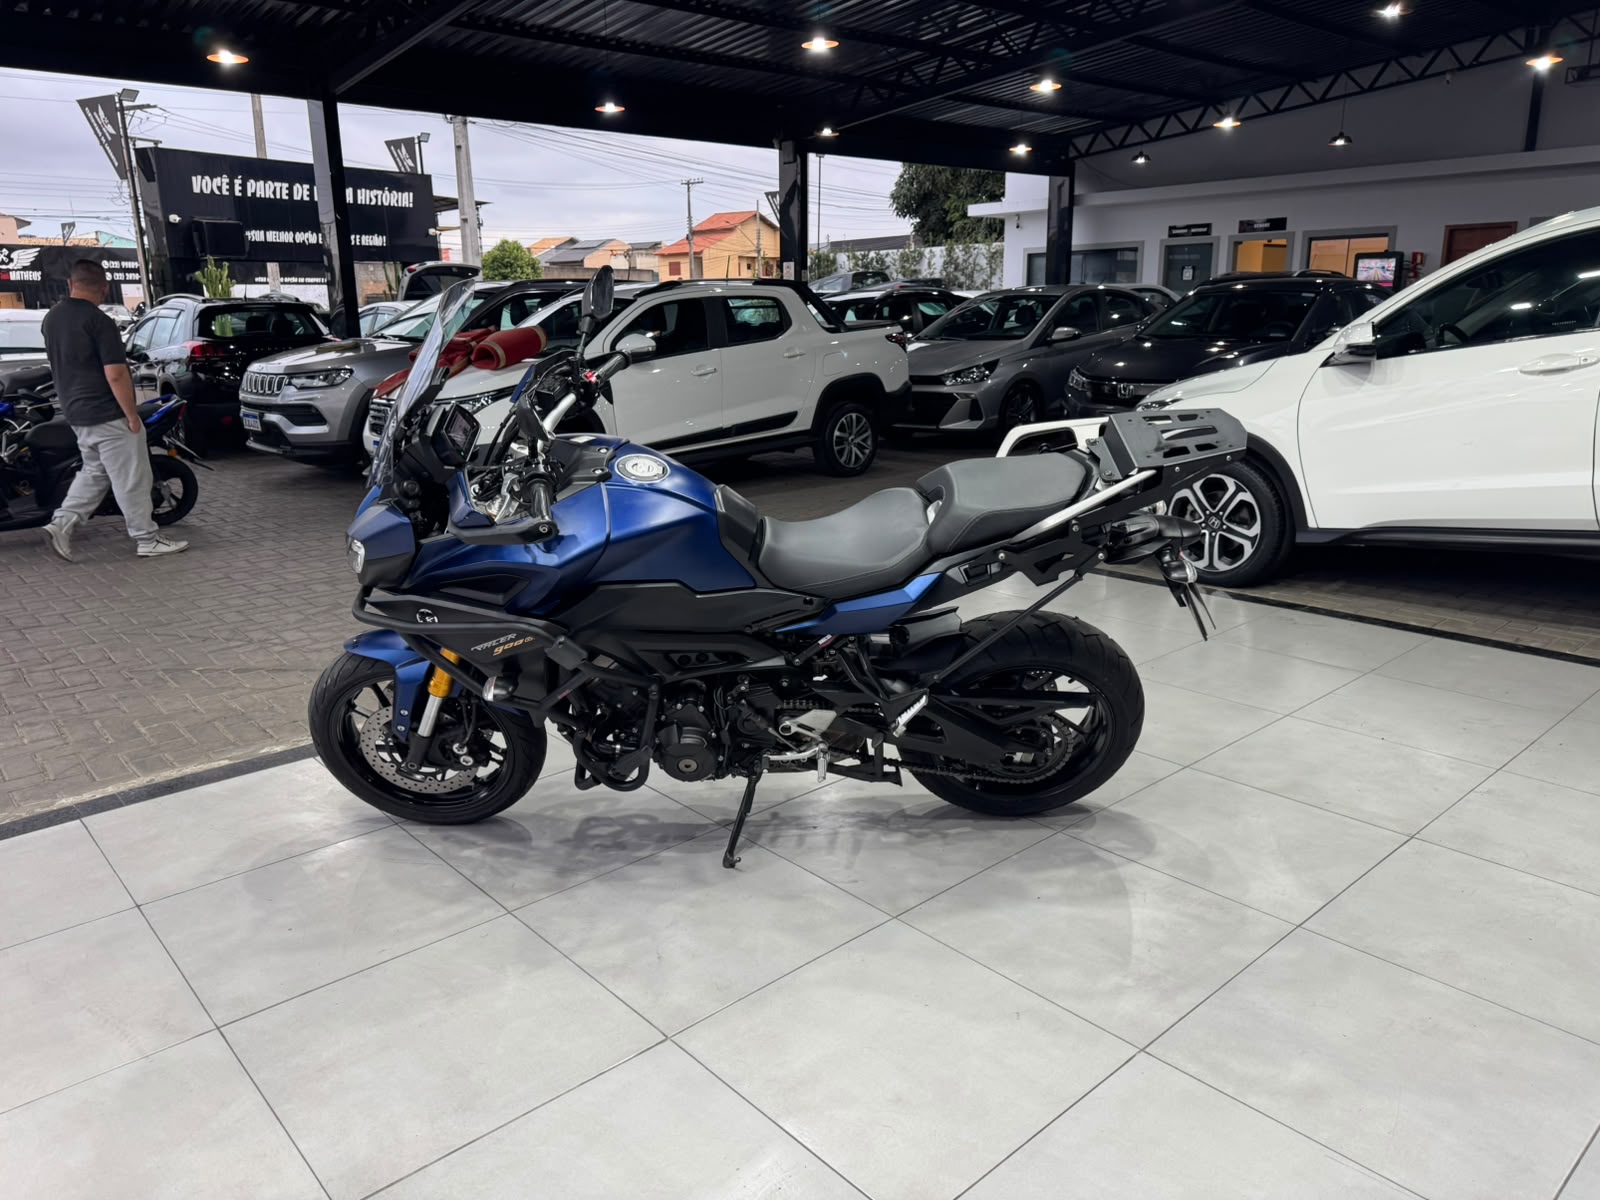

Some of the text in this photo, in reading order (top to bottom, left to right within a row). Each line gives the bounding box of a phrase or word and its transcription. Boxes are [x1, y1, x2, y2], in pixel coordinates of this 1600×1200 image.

[191, 174, 230, 196] VOCÊ
[234, 175, 243, 197] É
[246, 179, 289, 200] PARTE
[293, 182, 311, 201] DE
[356, 187, 414, 208] HISTÓRIA!
[265, 230, 294, 243] MELHOR
[294, 231, 318, 246] OPÇÃO
[9, 270, 42, 282] MATHEUS
